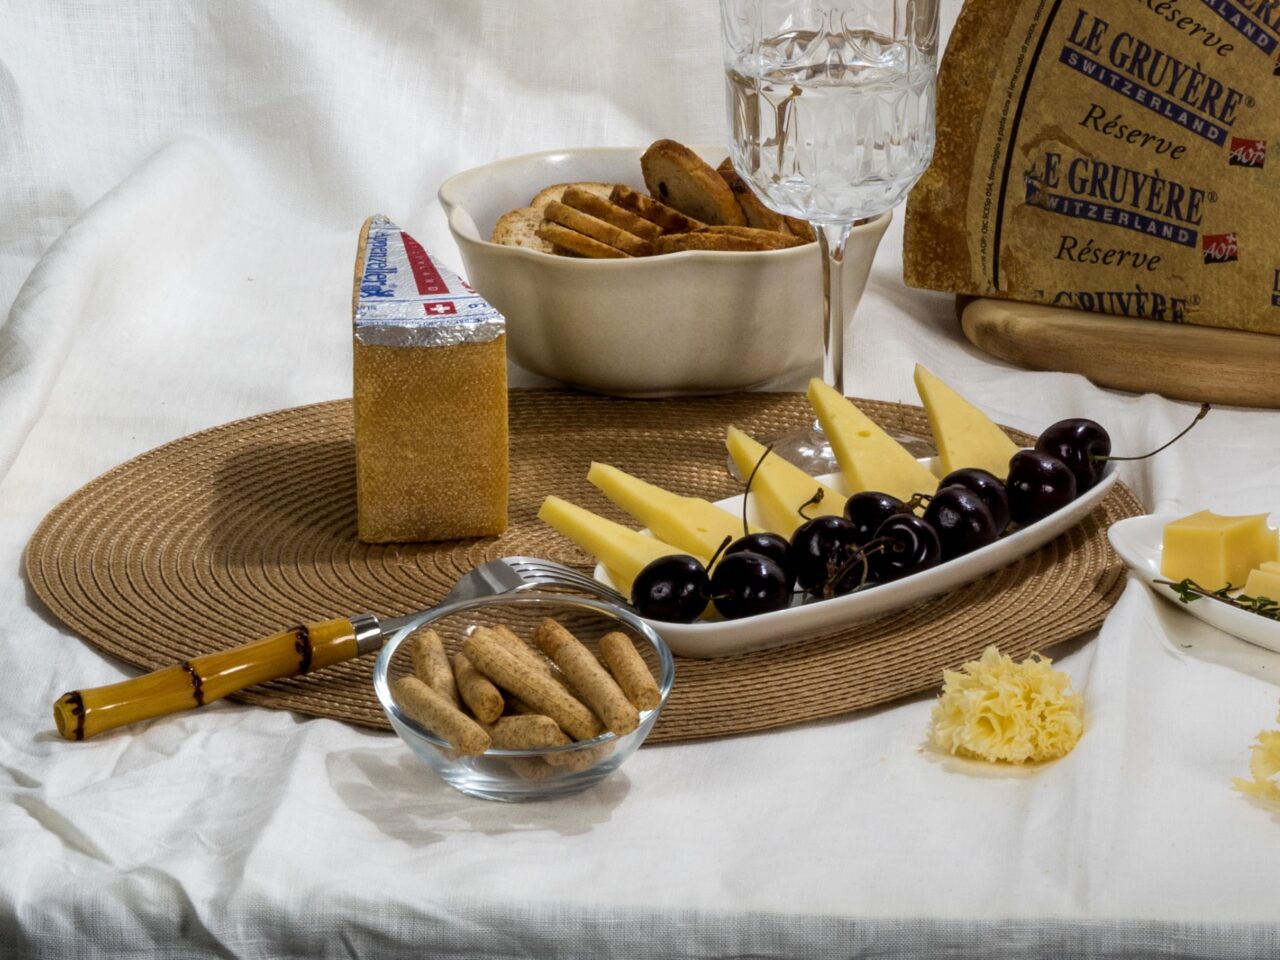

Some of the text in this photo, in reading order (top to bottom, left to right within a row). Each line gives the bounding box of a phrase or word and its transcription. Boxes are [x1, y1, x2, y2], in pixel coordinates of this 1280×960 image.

[1066, 8, 1110, 56] LE
[1067, 53, 1220, 141] SWITZERLAND
[1079, 103, 1187, 160] Réserve
[1230, 146, 1265, 166] AOP
[1049, 197, 1191, 243] WITZERLAND
[1055, 235, 1161, 272] Réserve
[1204, 240, 1237, 261] AOP
